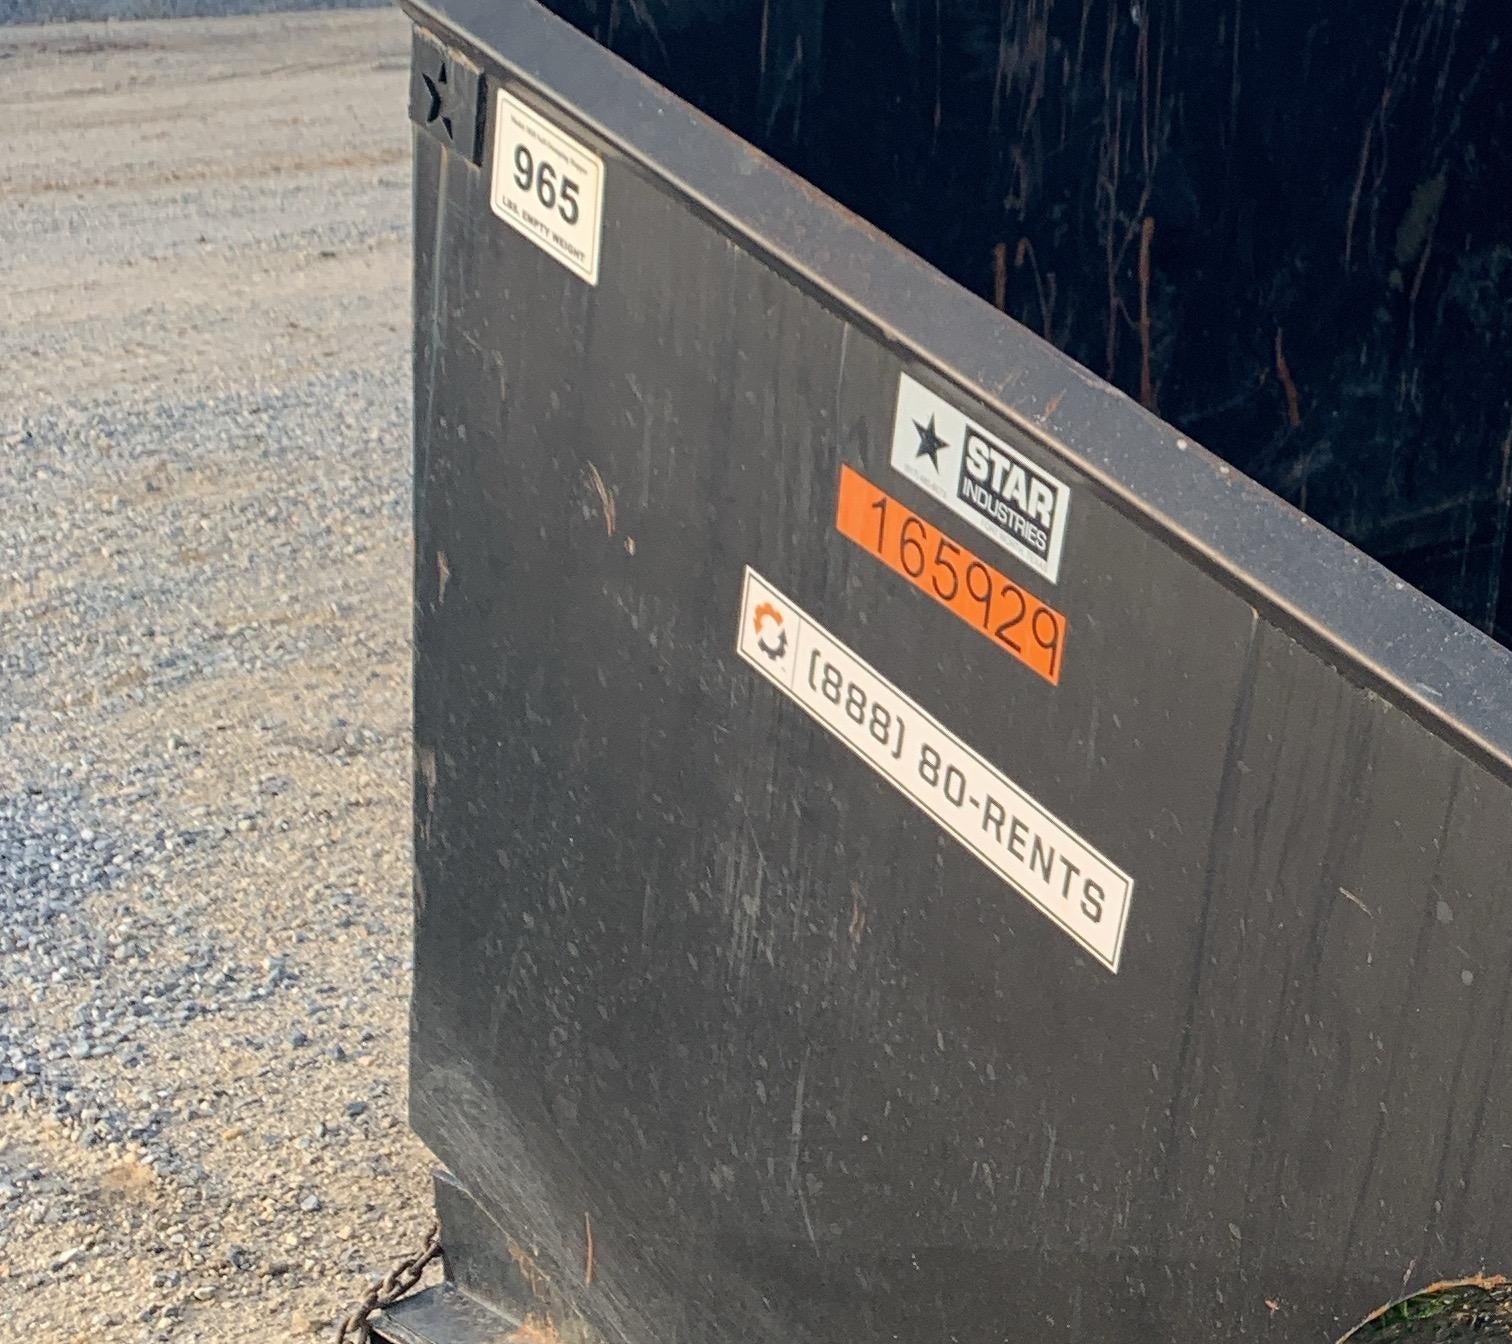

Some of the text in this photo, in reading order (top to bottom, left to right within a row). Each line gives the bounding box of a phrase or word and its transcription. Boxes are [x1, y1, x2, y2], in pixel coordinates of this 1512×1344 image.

[513, 144, 580, 226] 965
[522, 208, 550, 237] EMPTY
[552, 231, 585, 262] WEIGHT
[962, 477, 1048, 552] INDUSTRIES
[966, 434, 1054, 528] STAR
[872, 496, 1059, 677] 165929
[808, 648, 1105, 924] (888) 80-RENTS
